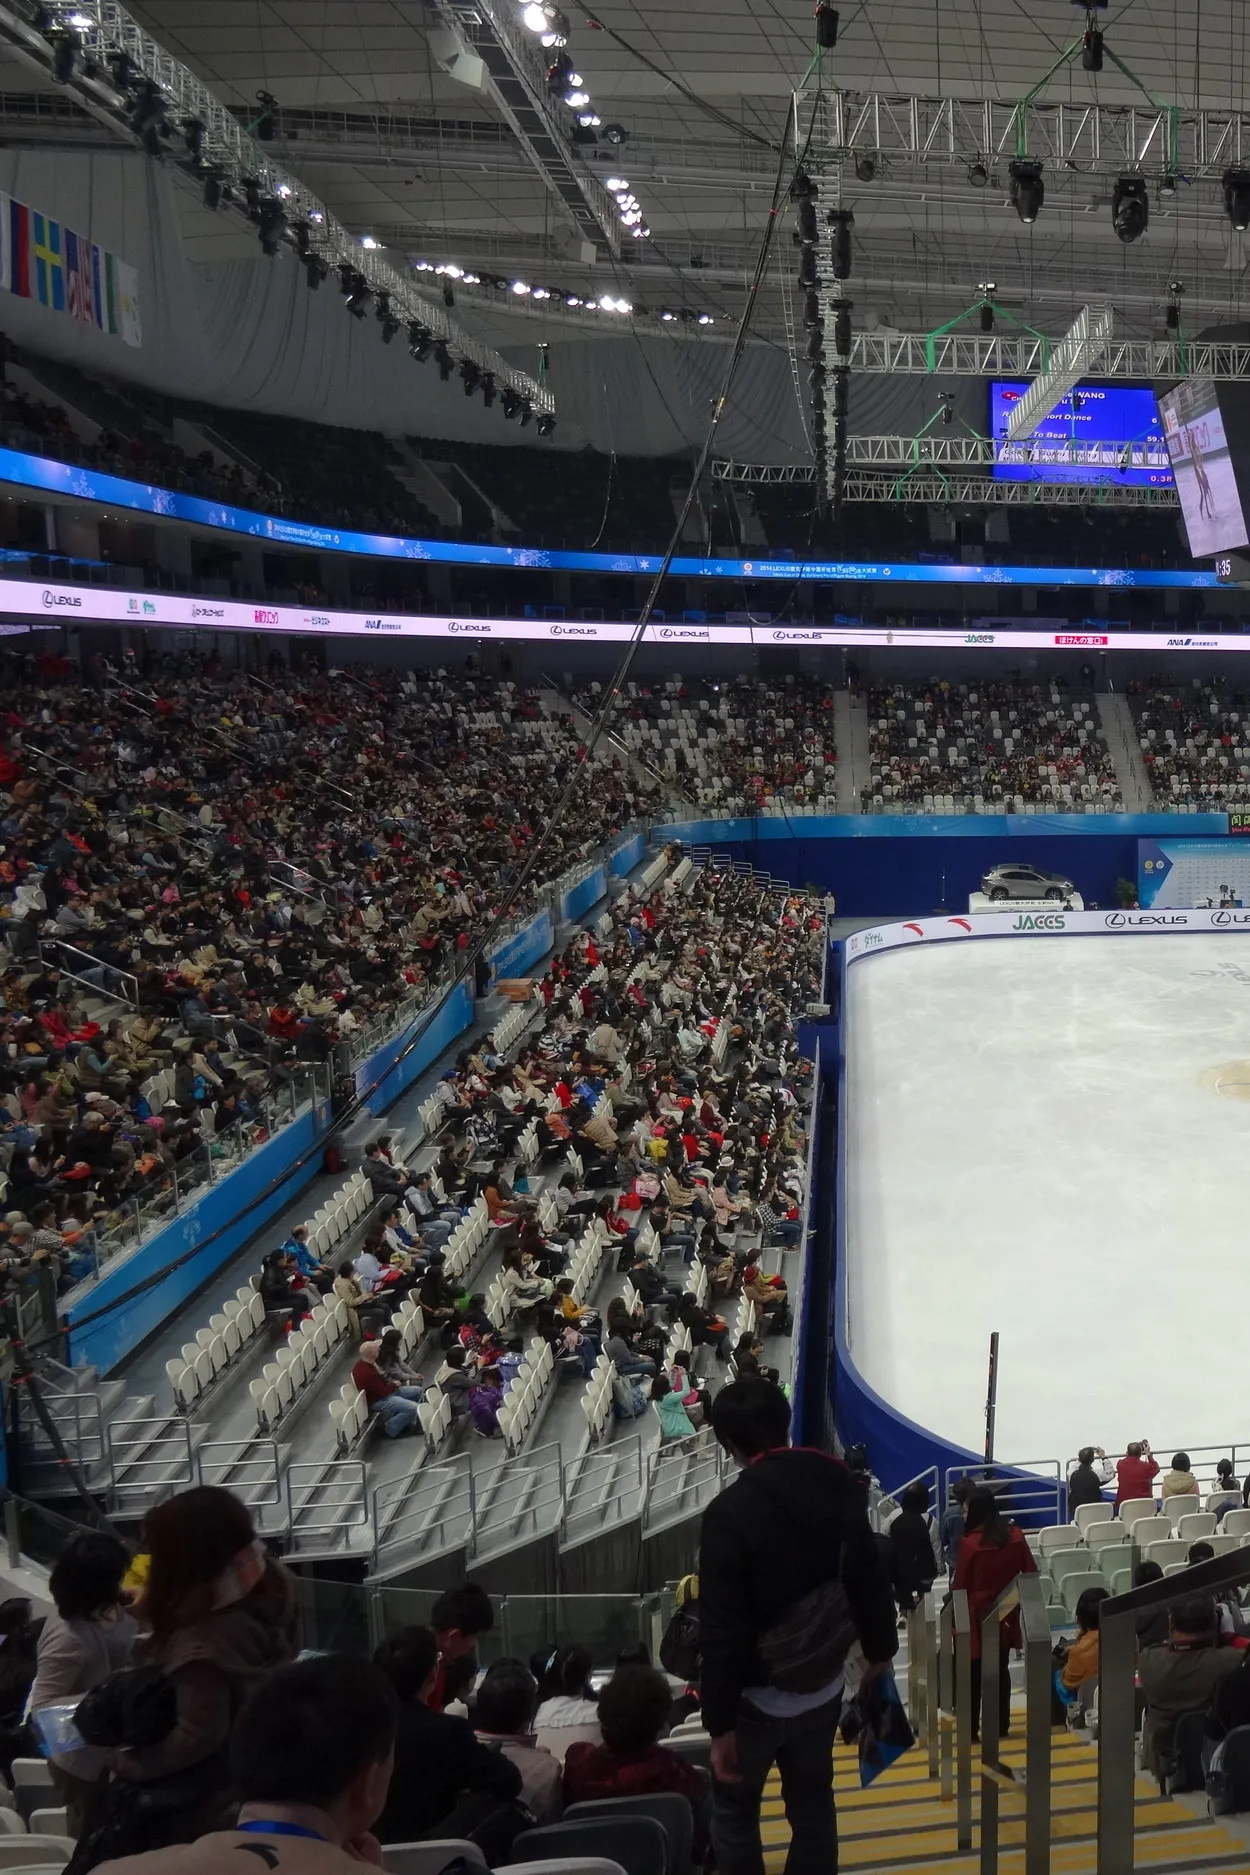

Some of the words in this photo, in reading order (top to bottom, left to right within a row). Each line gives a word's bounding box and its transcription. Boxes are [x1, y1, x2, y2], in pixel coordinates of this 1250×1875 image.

[54, 596, 82, 608] LEXUS
[459, 625, 491, 633] LEXUS
[564, 627, 597, 636] LEXUS
[673, 630, 709, 638] LEXUS
[785, 632, 822, 640] LEXUS
[1167, 639, 1184, 647] ANA
[1012, 914, 1066, 931] JACCS
[1128, 916, 1188, 926] LEXUS
